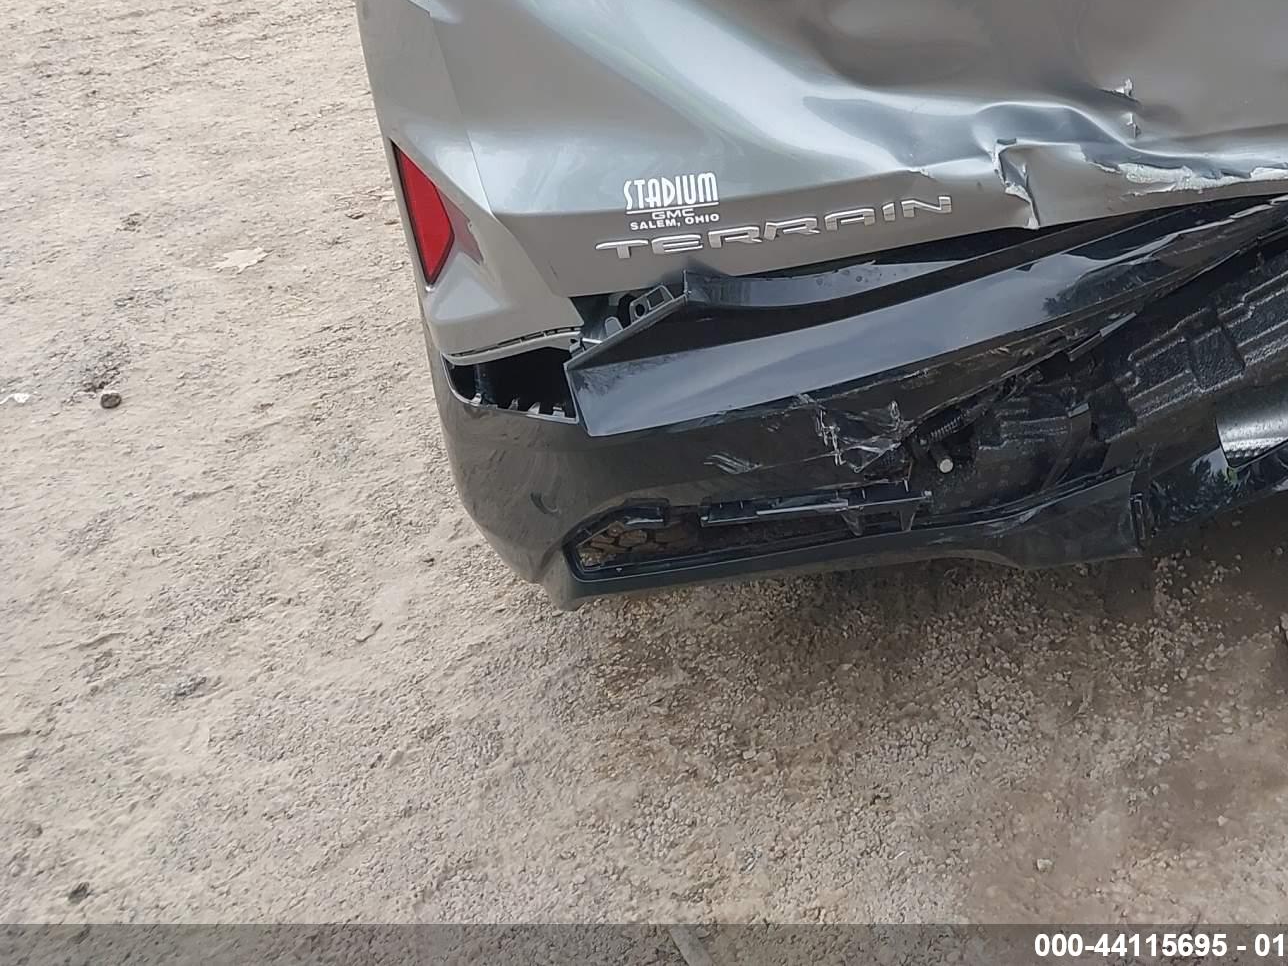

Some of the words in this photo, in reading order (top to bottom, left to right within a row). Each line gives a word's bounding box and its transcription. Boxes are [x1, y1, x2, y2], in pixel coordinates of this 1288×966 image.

[623, 172, 719, 210] STADIUM
[595, 195, 952, 259] TERRAIN
[630, 219, 681, 230] SALEM,
[684, 213, 720, 225] OHIO
[651, 208, 695, 220] GMC
